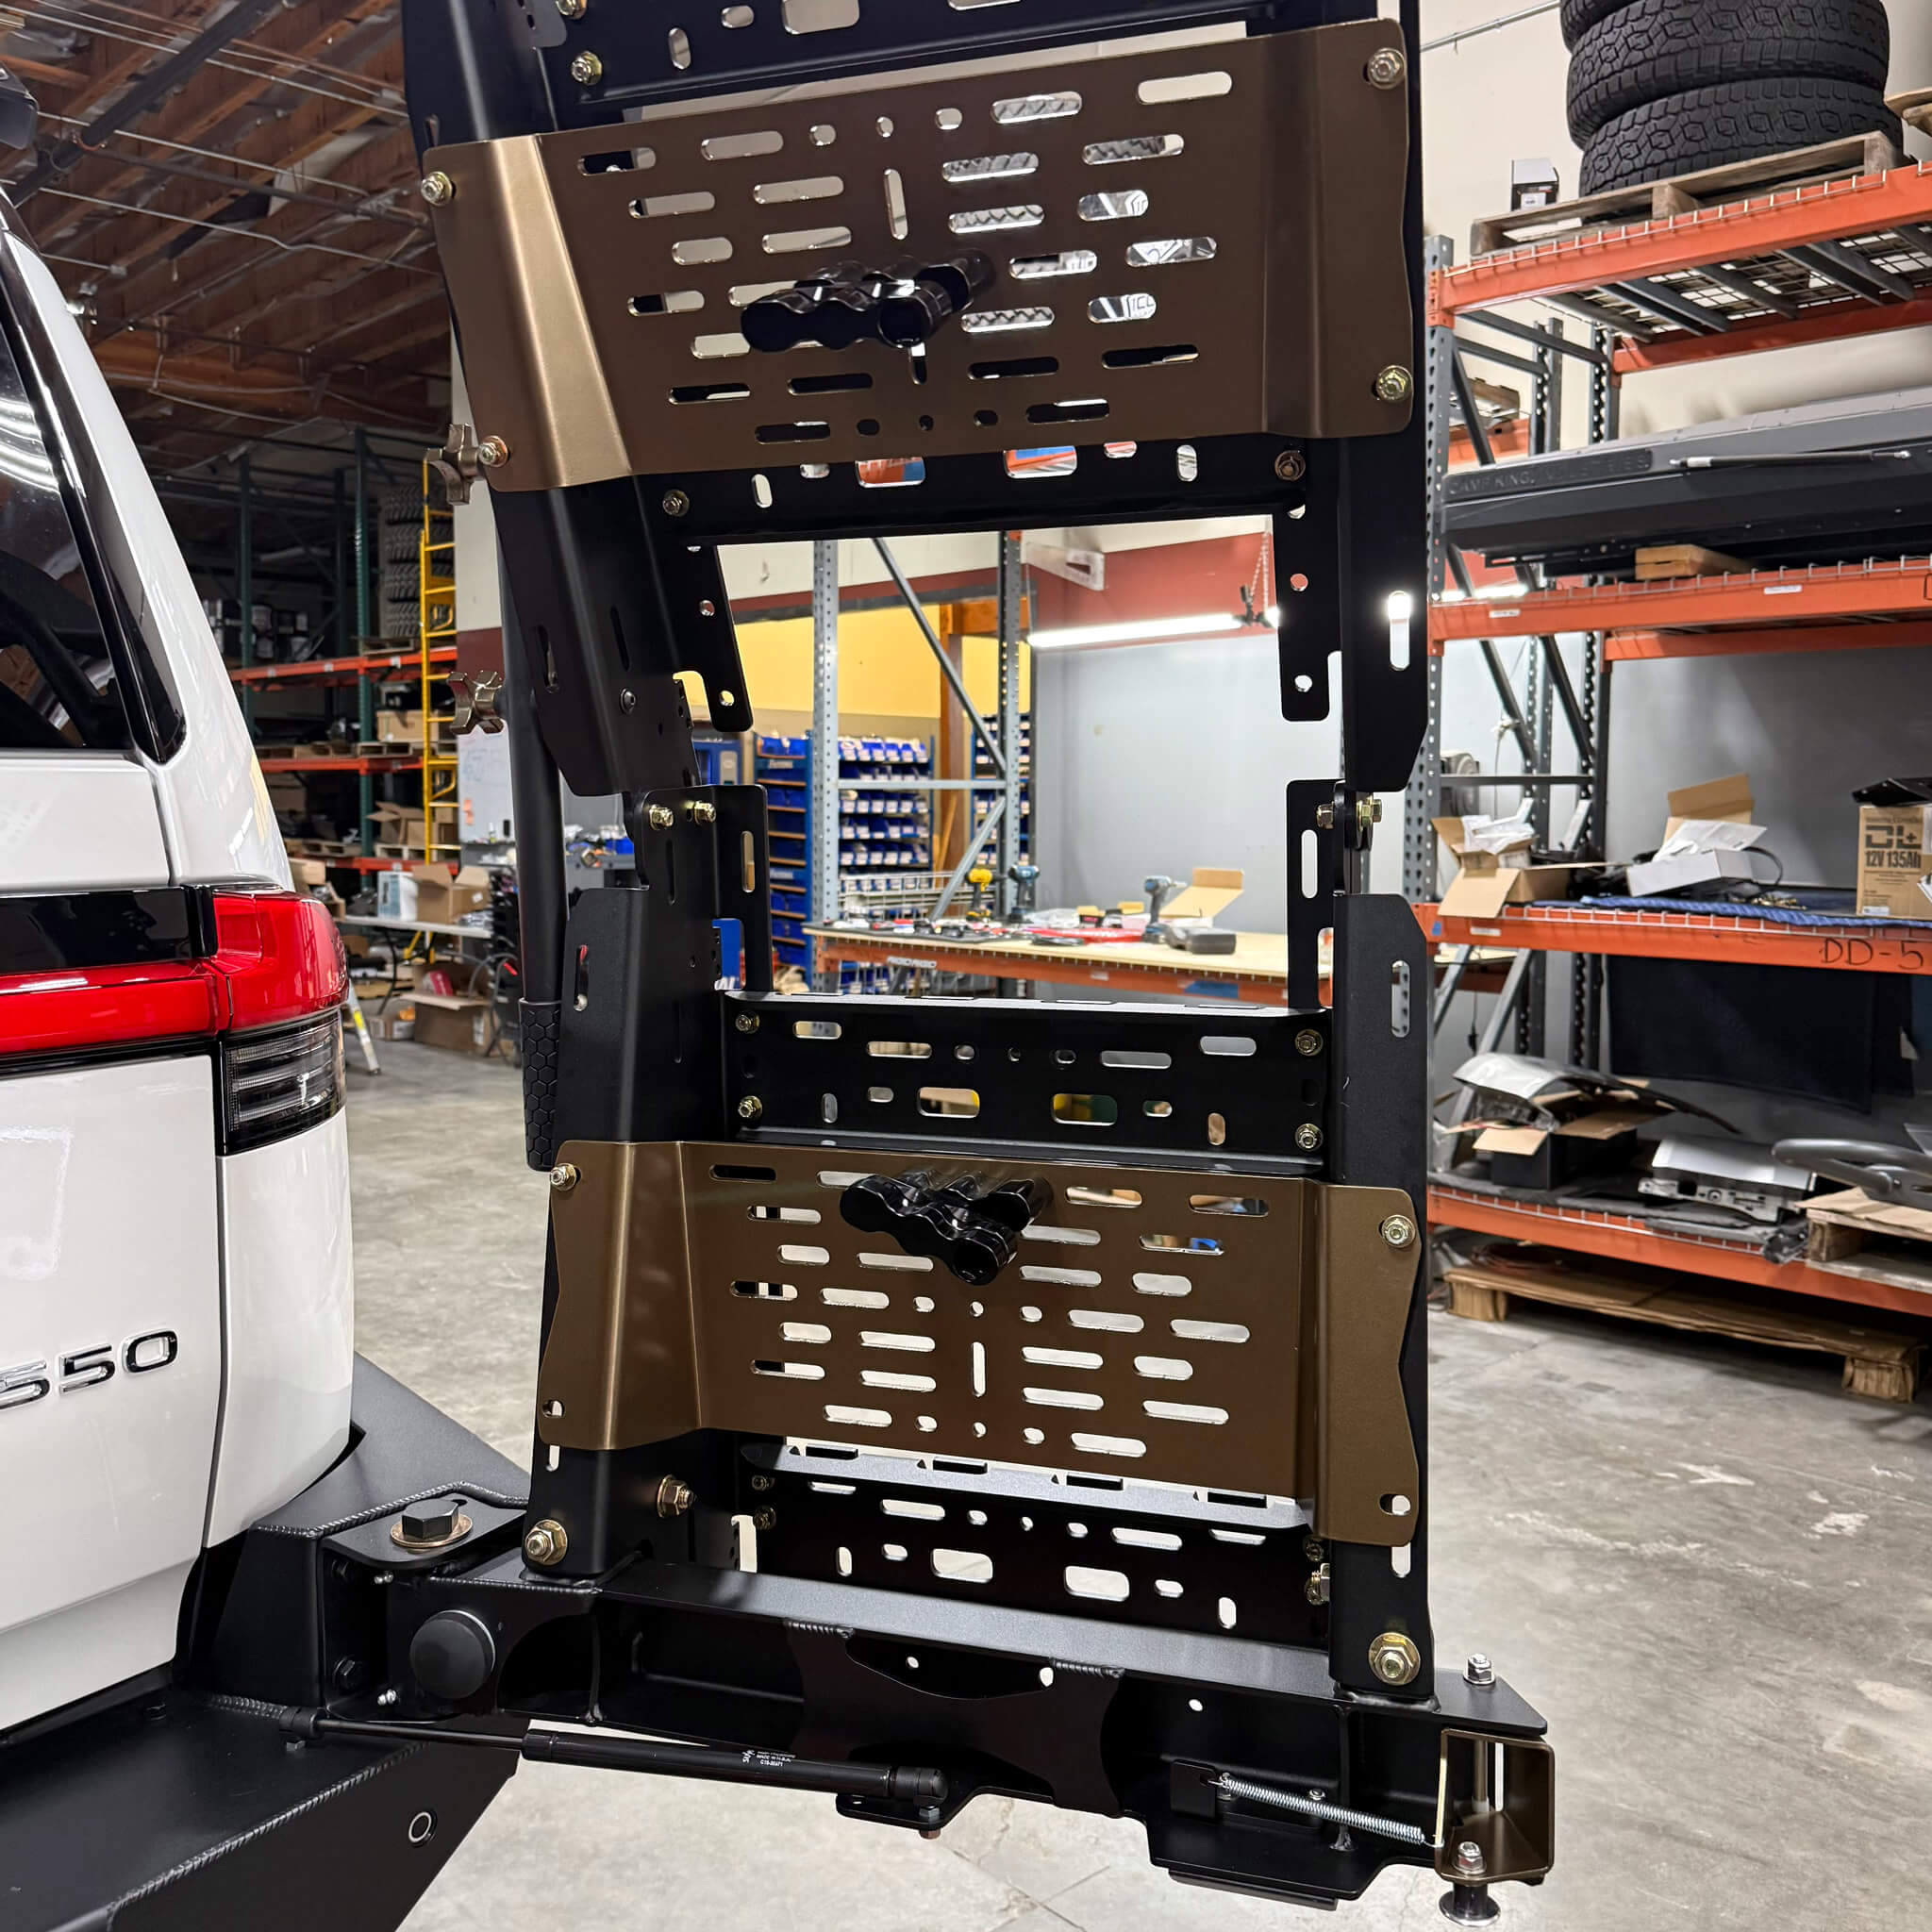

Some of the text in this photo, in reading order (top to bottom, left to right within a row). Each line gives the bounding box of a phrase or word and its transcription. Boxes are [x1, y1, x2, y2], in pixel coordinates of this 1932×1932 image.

[1865, 850, 1922, 869] 12V 135Ah
[1820, 937, 1924, 970] DD-5
